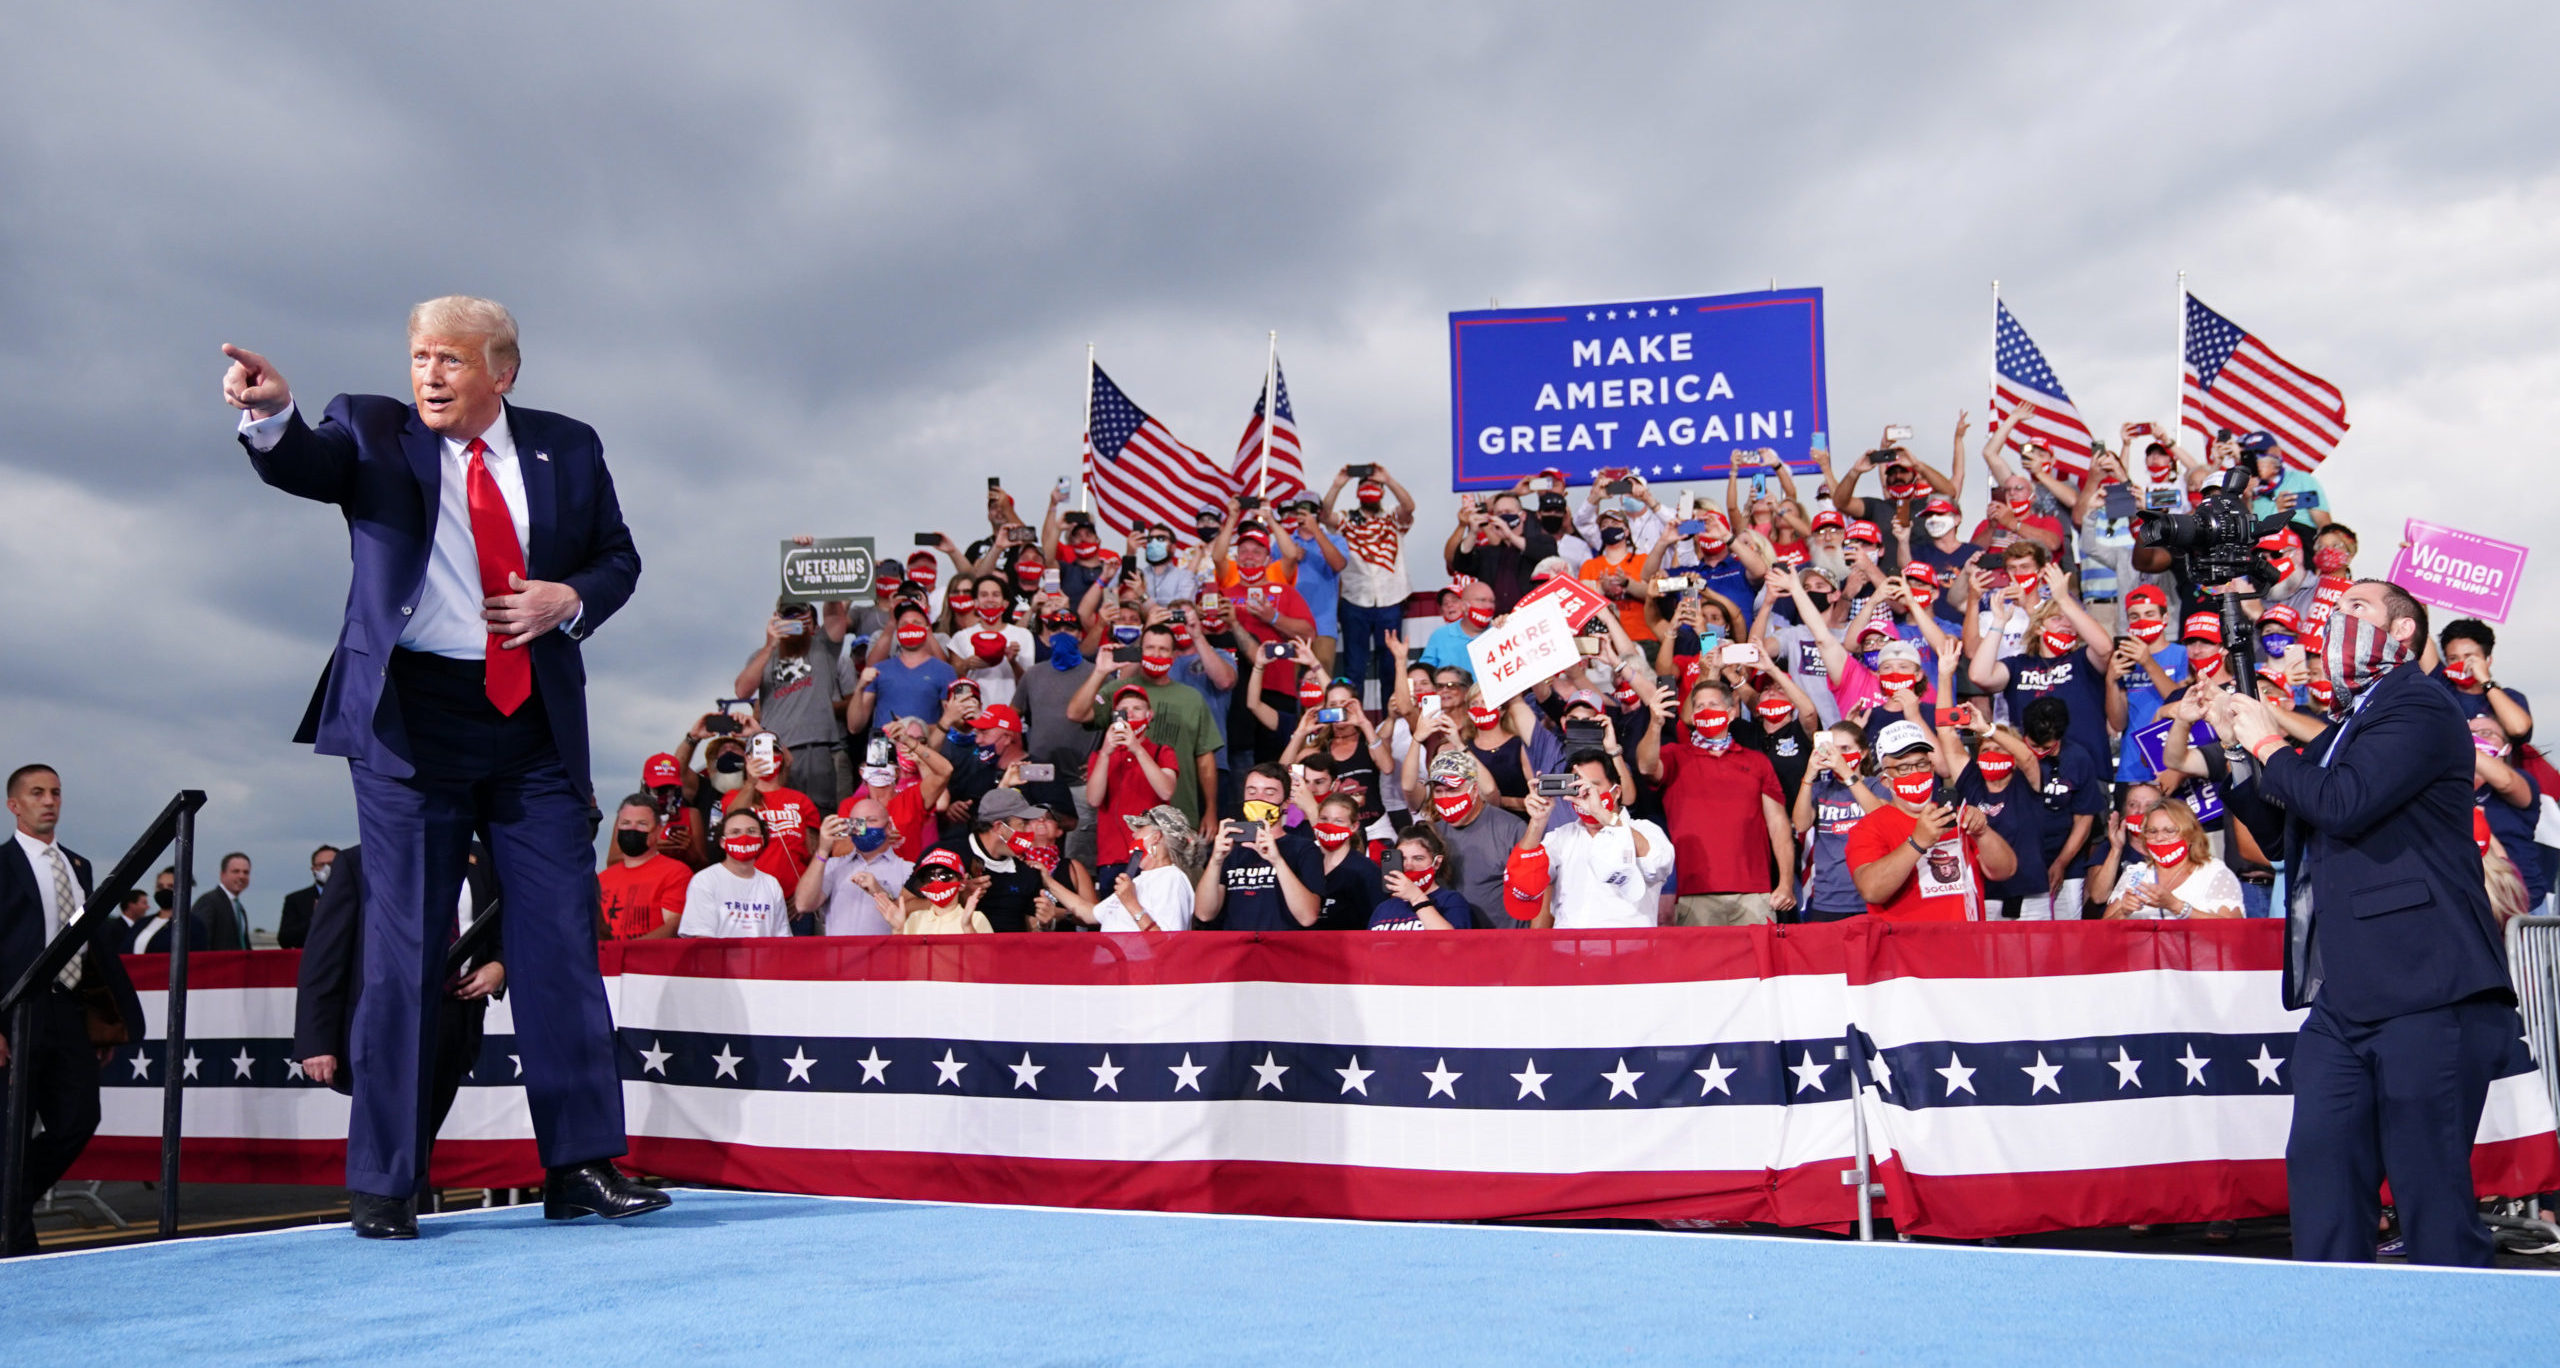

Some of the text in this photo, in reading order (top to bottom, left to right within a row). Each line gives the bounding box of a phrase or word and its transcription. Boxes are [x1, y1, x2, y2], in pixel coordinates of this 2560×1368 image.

[1573, 332, 1693, 368] MAKE
[1534, 372, 1734, 412] AMERICA
[1479, 410, 1794, 455] GREAT AGAIN!
[795, 557, 865, 576] VETERANS
[1018, 565, 1042, 574] TRUMP
[2410, 542, 2503, 588] Women
[803, 573, 858, 585] FOR TRUMP
[910, 571, 935, 580] TRUMP
[2414, 569, 2490, 596] FOR TRUMP
[899, 630, 926, 640] TRUMP
[1486, 651, 1496, 665] 4
[1142, 661, 1171, 672] TRUMP
[2020, 664, 2072, 686] TRUMP
[1881, 679, 1913, 691] TRUMP
[1759, 704, 1793, 716] TRUMP
[1695, 717, 1727, 728] TRUMP
[1977, 761, 2012, 770] TRUMP
[1897, 779, 1934, 794] TRUMP
[1818, 803, 1865, 821] TRUM
[1314, 828, 1350, 841] TRUMP
[727, 842, 762, 853] TRUMP
[1229, 876, 1275, 885] PENCE
[921, 887, 957, 902] TRUMP
[725, 901, 771, 911] TRUMP
[729, 911, 766, 921] PENCE
